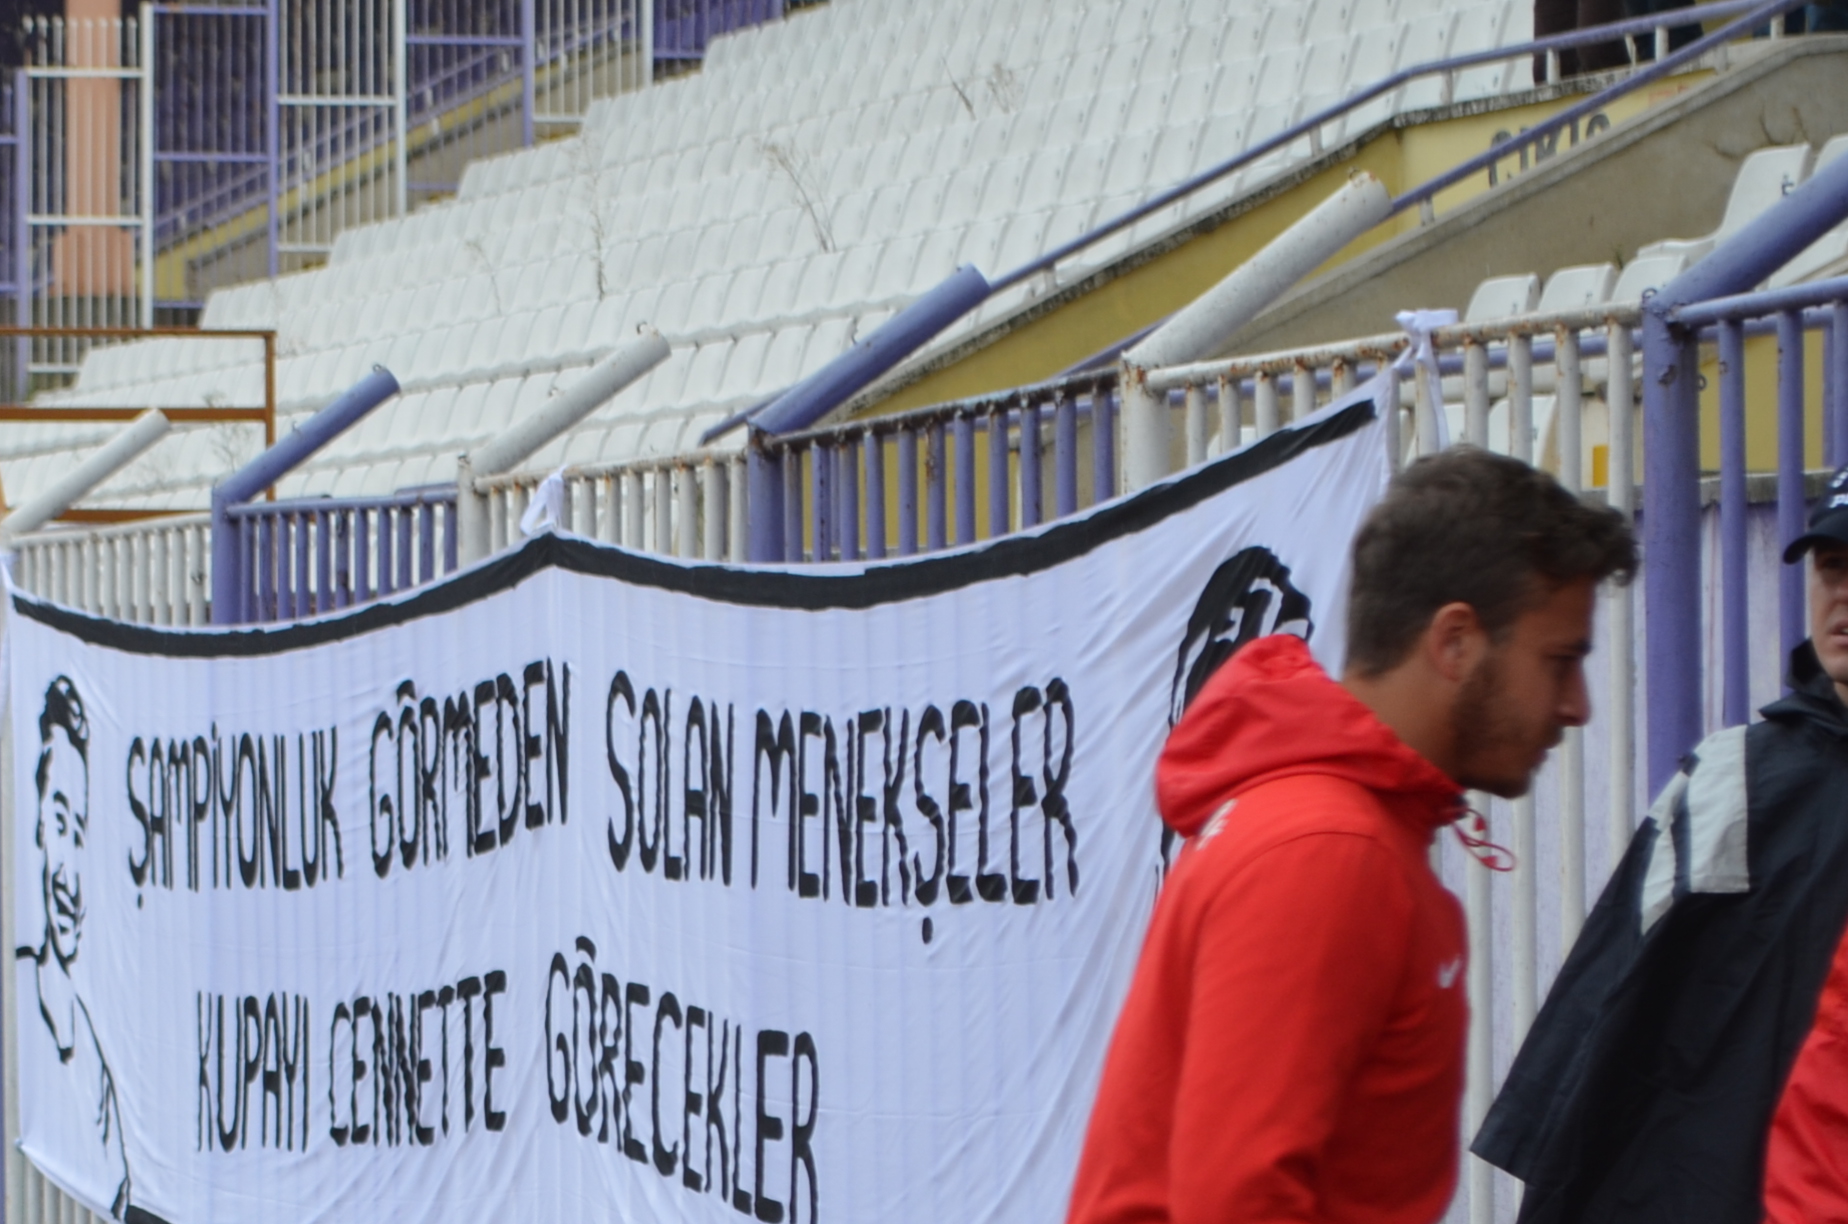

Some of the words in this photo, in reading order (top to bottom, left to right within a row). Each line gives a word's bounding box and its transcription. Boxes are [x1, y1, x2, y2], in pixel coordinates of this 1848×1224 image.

[126, 722, 344, 909] ŞAMPİYONLUK
[369, 655, 571, 880] GÖRMEDEN
[605, 669, 735, 888] SOLAN
[751, 676, 1080, 945] MENEKŞELER
[196, 991, 310, 1154] KUPAYI
[327, 969, 507, 1148] CENNETTE
